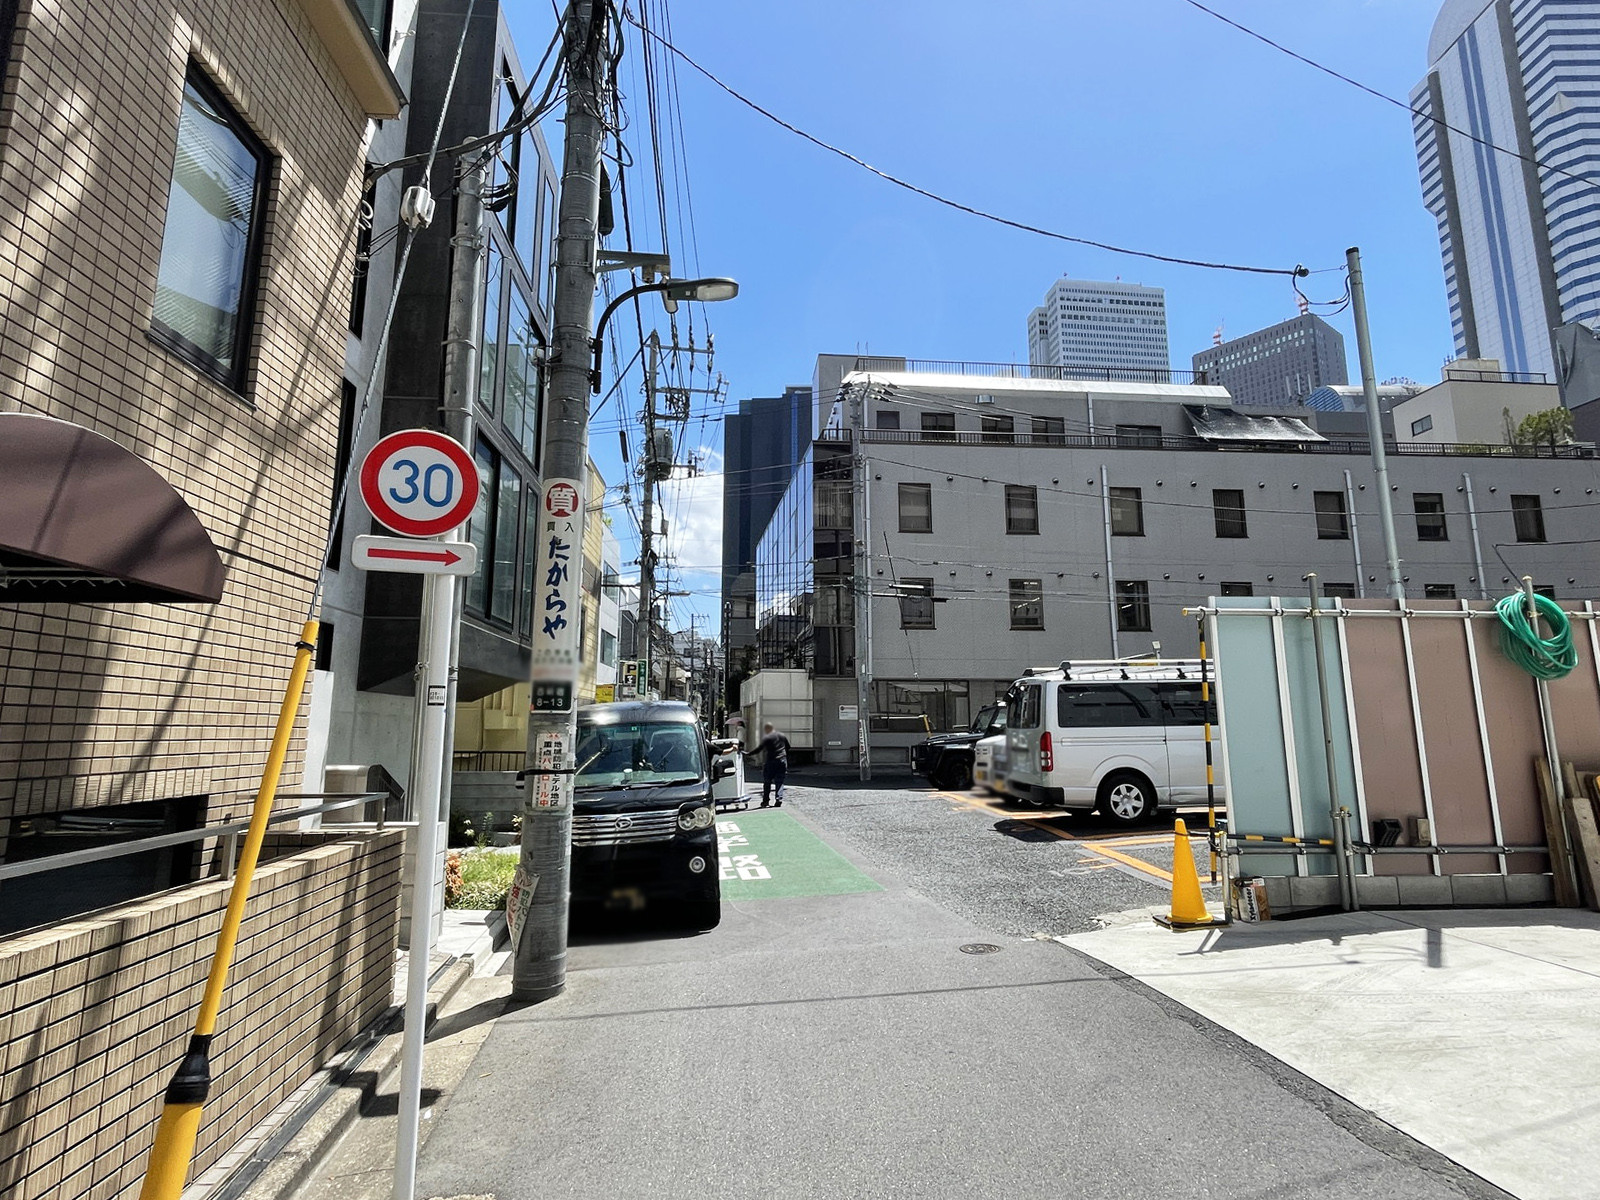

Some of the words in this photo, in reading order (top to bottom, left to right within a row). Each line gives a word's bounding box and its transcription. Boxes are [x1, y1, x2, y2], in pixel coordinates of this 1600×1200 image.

[389, 459, 454, 508] 30
[549, 487, 576, 514] 質
[542, 535, 571, 640] たからや
[536, 698, 563, 707] 8-13
